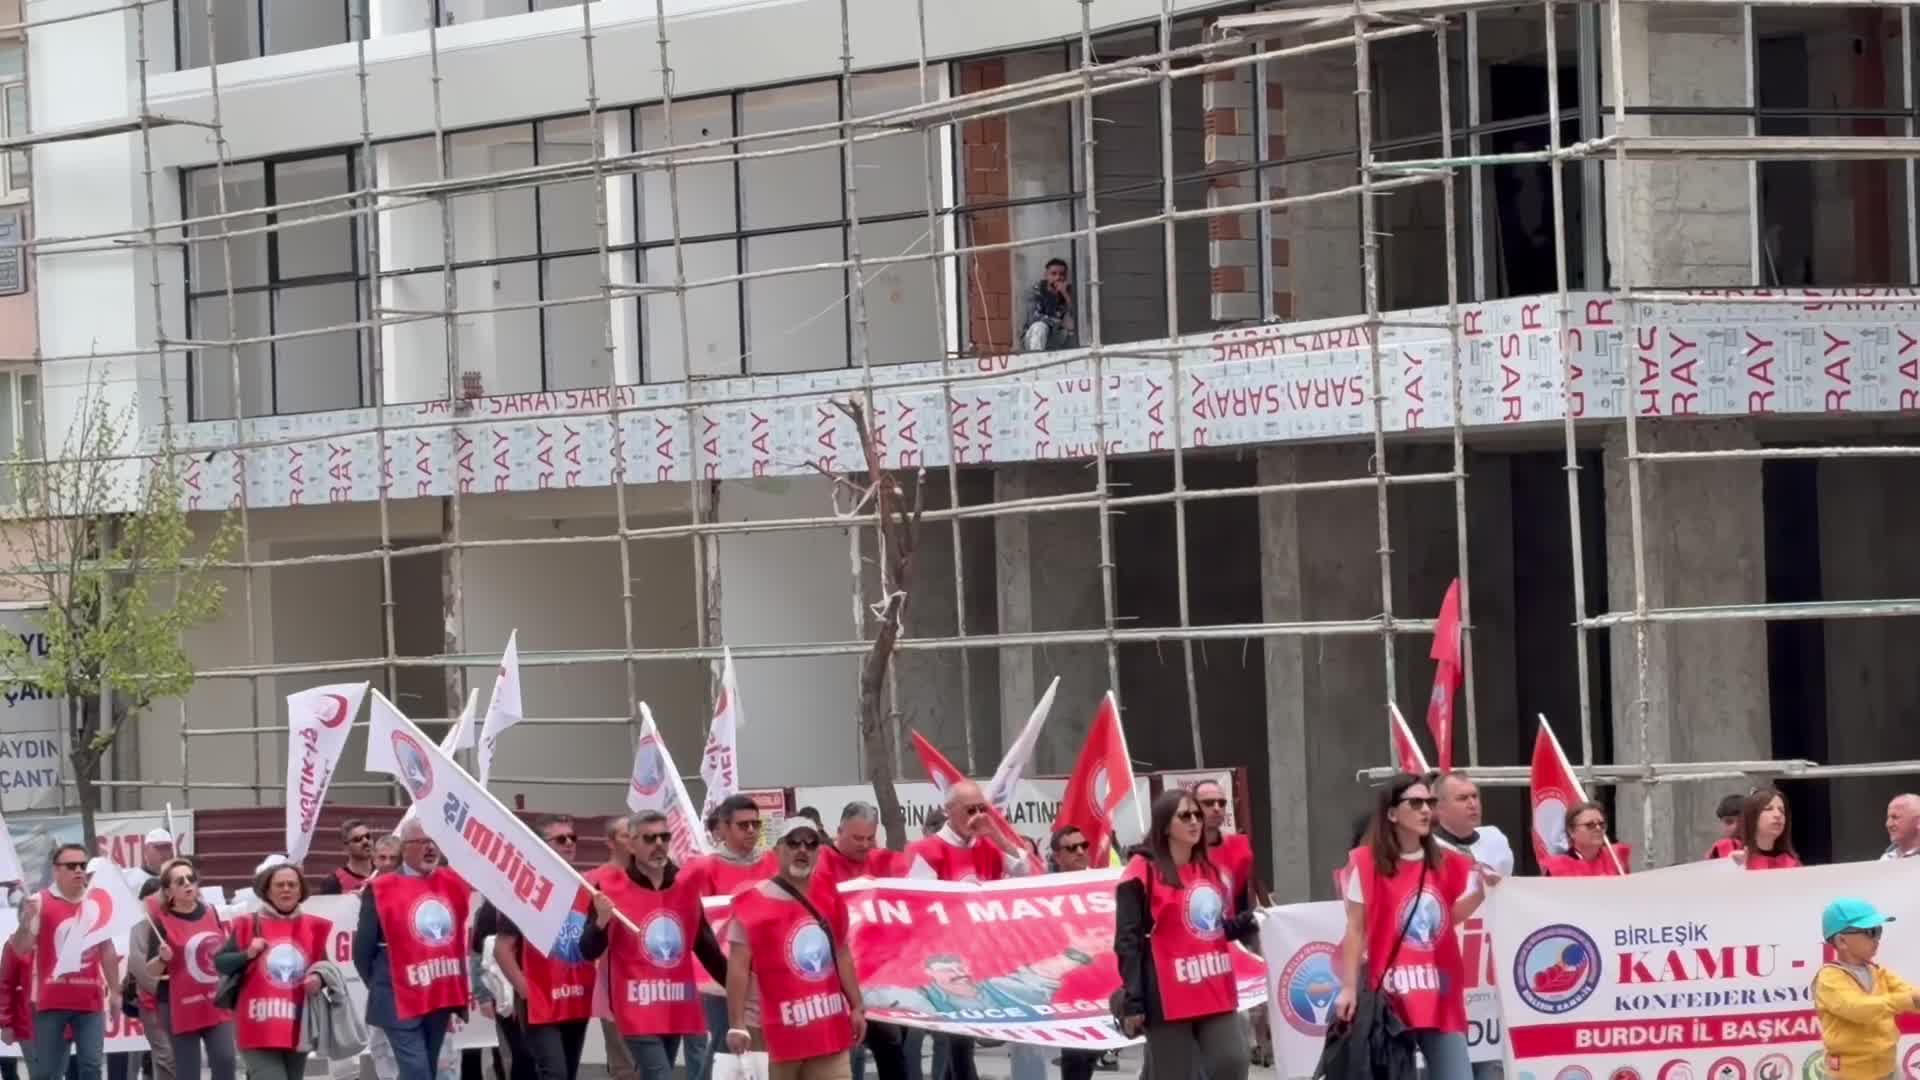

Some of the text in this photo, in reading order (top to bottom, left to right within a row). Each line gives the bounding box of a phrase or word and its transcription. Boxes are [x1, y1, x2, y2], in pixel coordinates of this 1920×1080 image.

[1669, 332, 1698, 416] RAY
[1746, 331, 1776, 415] RAY
[1824, 331, 1852, 415] RAY
[1897, 329, 1920, 415] RAY
[928, 901, 950, 925] 1
[966, 891, 1116, 923] MAYIS
[1614, 921, 1709, 948] BİRLEŞİK
[1616, 943, 1781, 985] KAMU
[1575, 1024, 1685, 1049] BURDUR
[1691, 1018, 1714, 1042] İL
